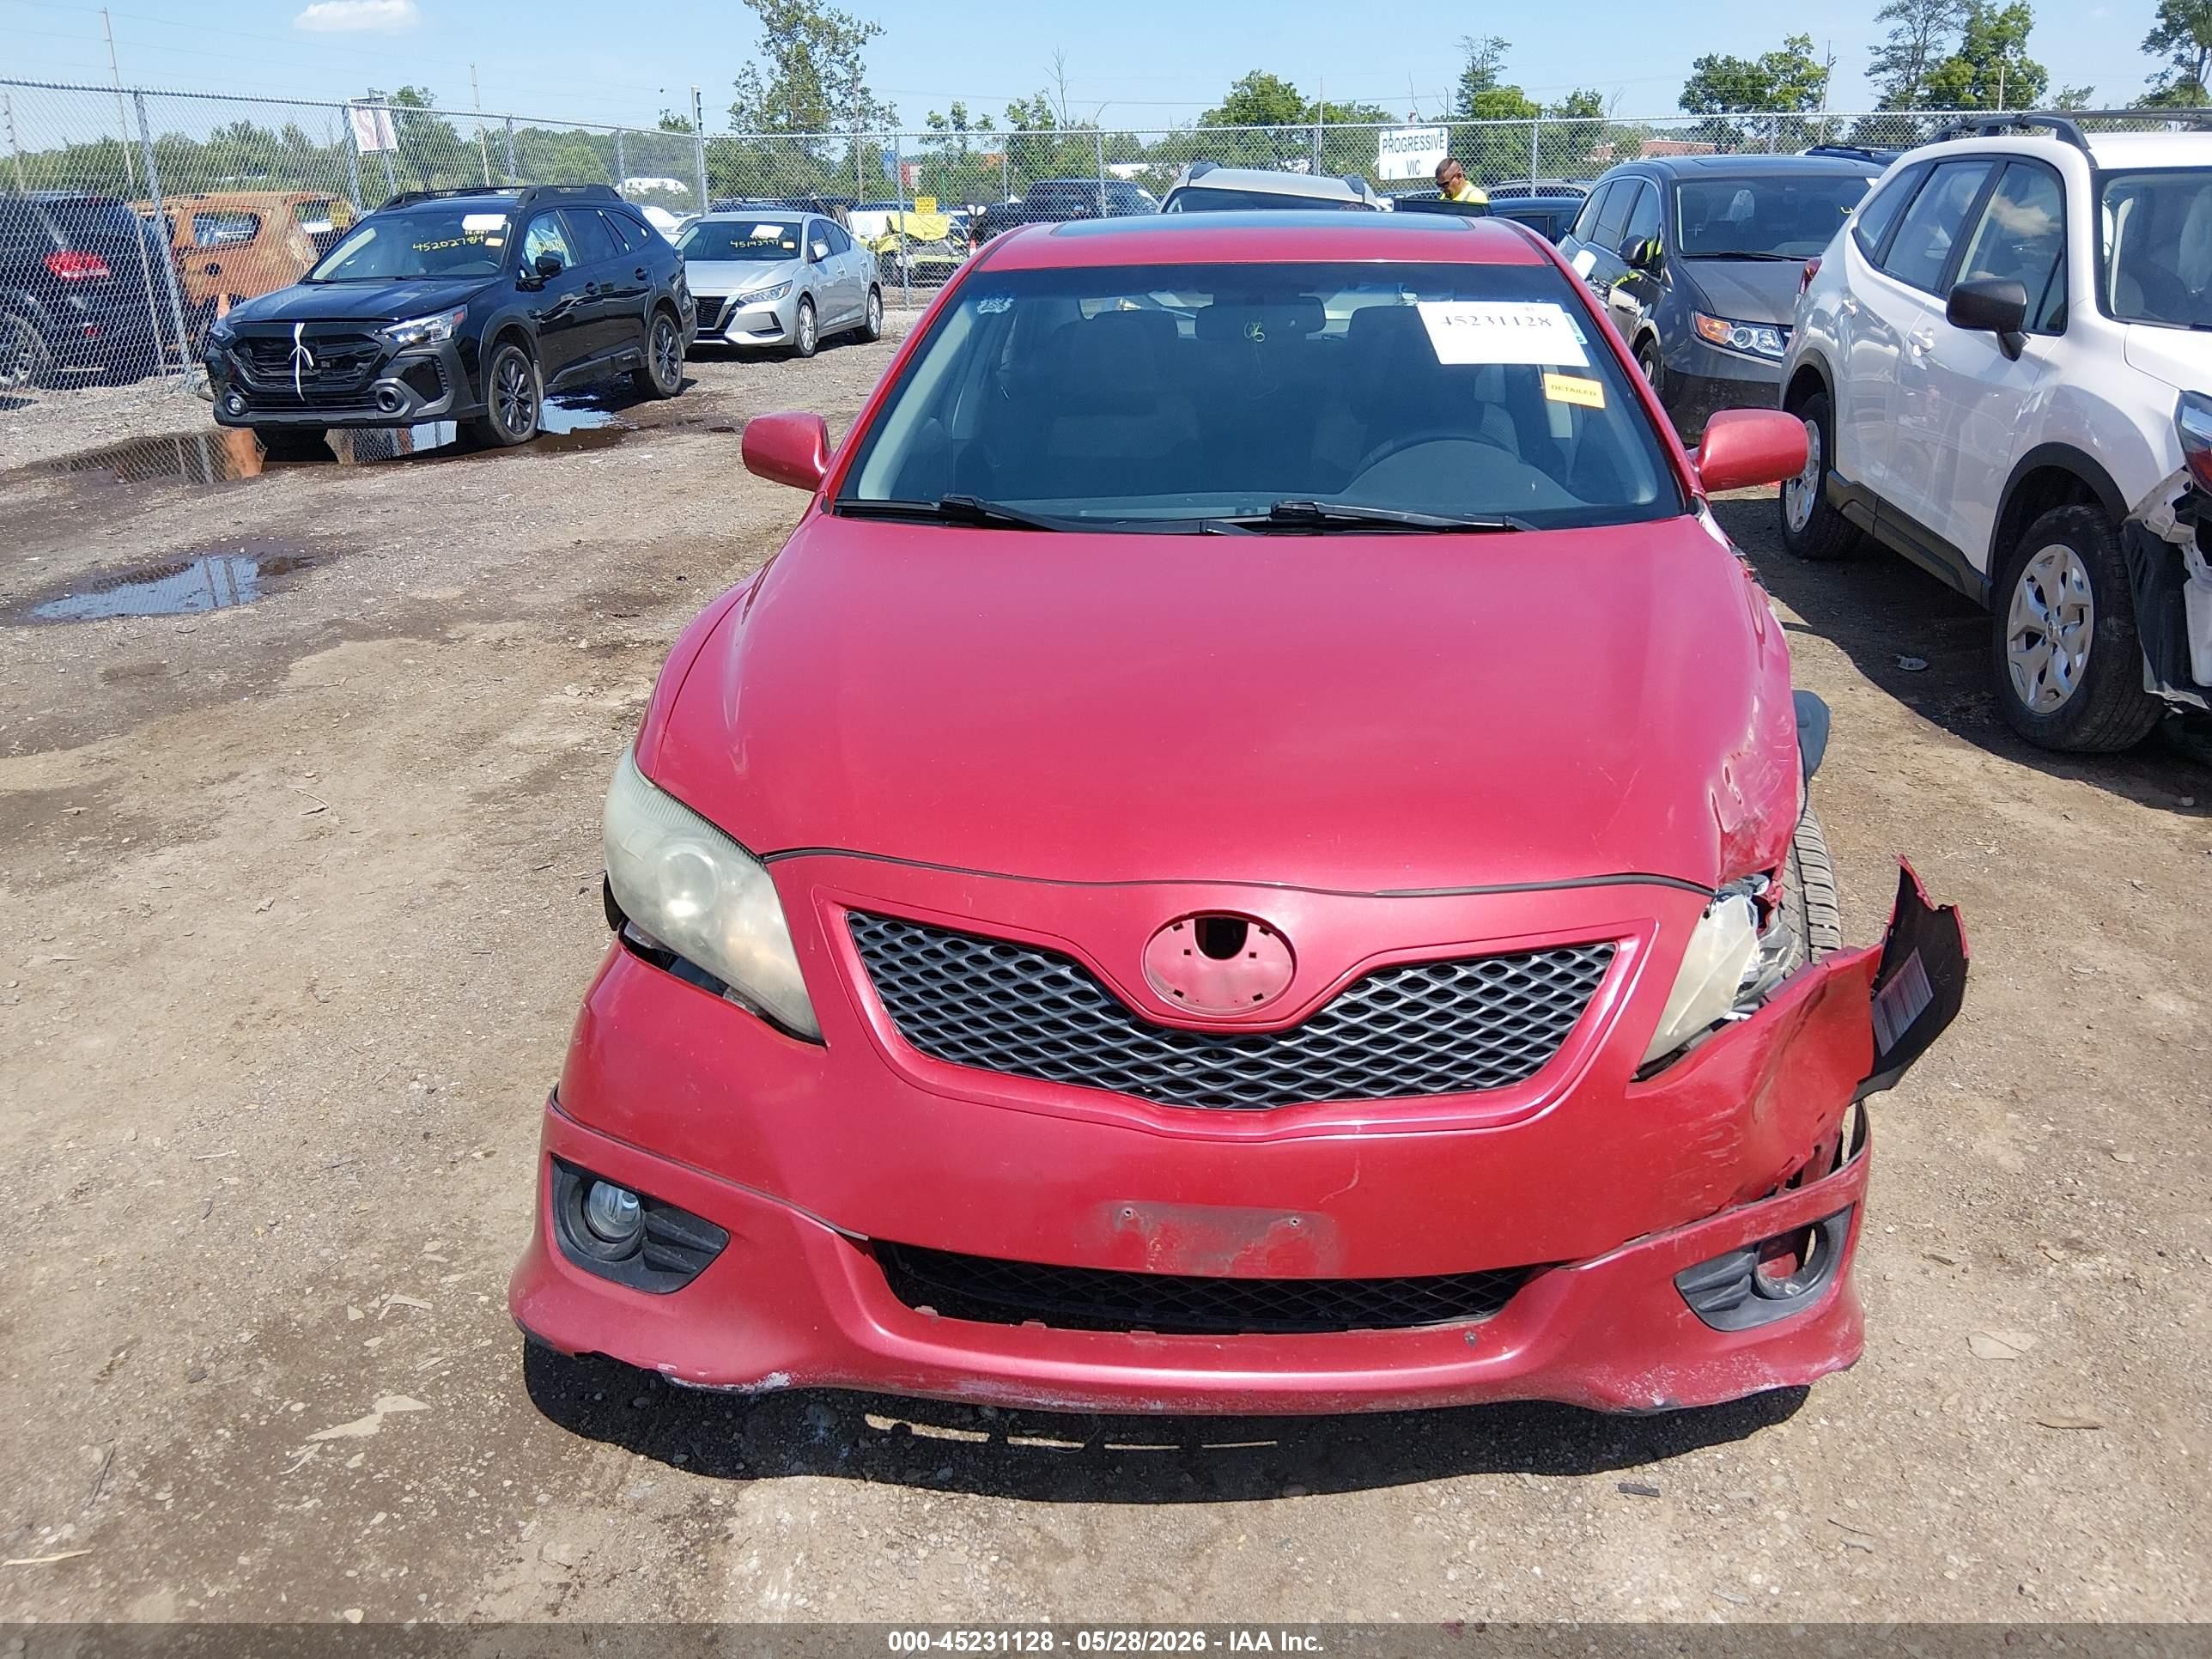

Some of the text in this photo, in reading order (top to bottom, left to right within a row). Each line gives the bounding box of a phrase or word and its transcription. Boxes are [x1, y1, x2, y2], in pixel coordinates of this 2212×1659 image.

[1382, 132, 1445, 155] PROGRESSIVE
[1407, 159, 1421, 176] VIC
[412, 234, 485, 252] 45202784
[1442, 315, 1553, 327] 45231128
[1551, 384, 1597, 397] DETAILED
